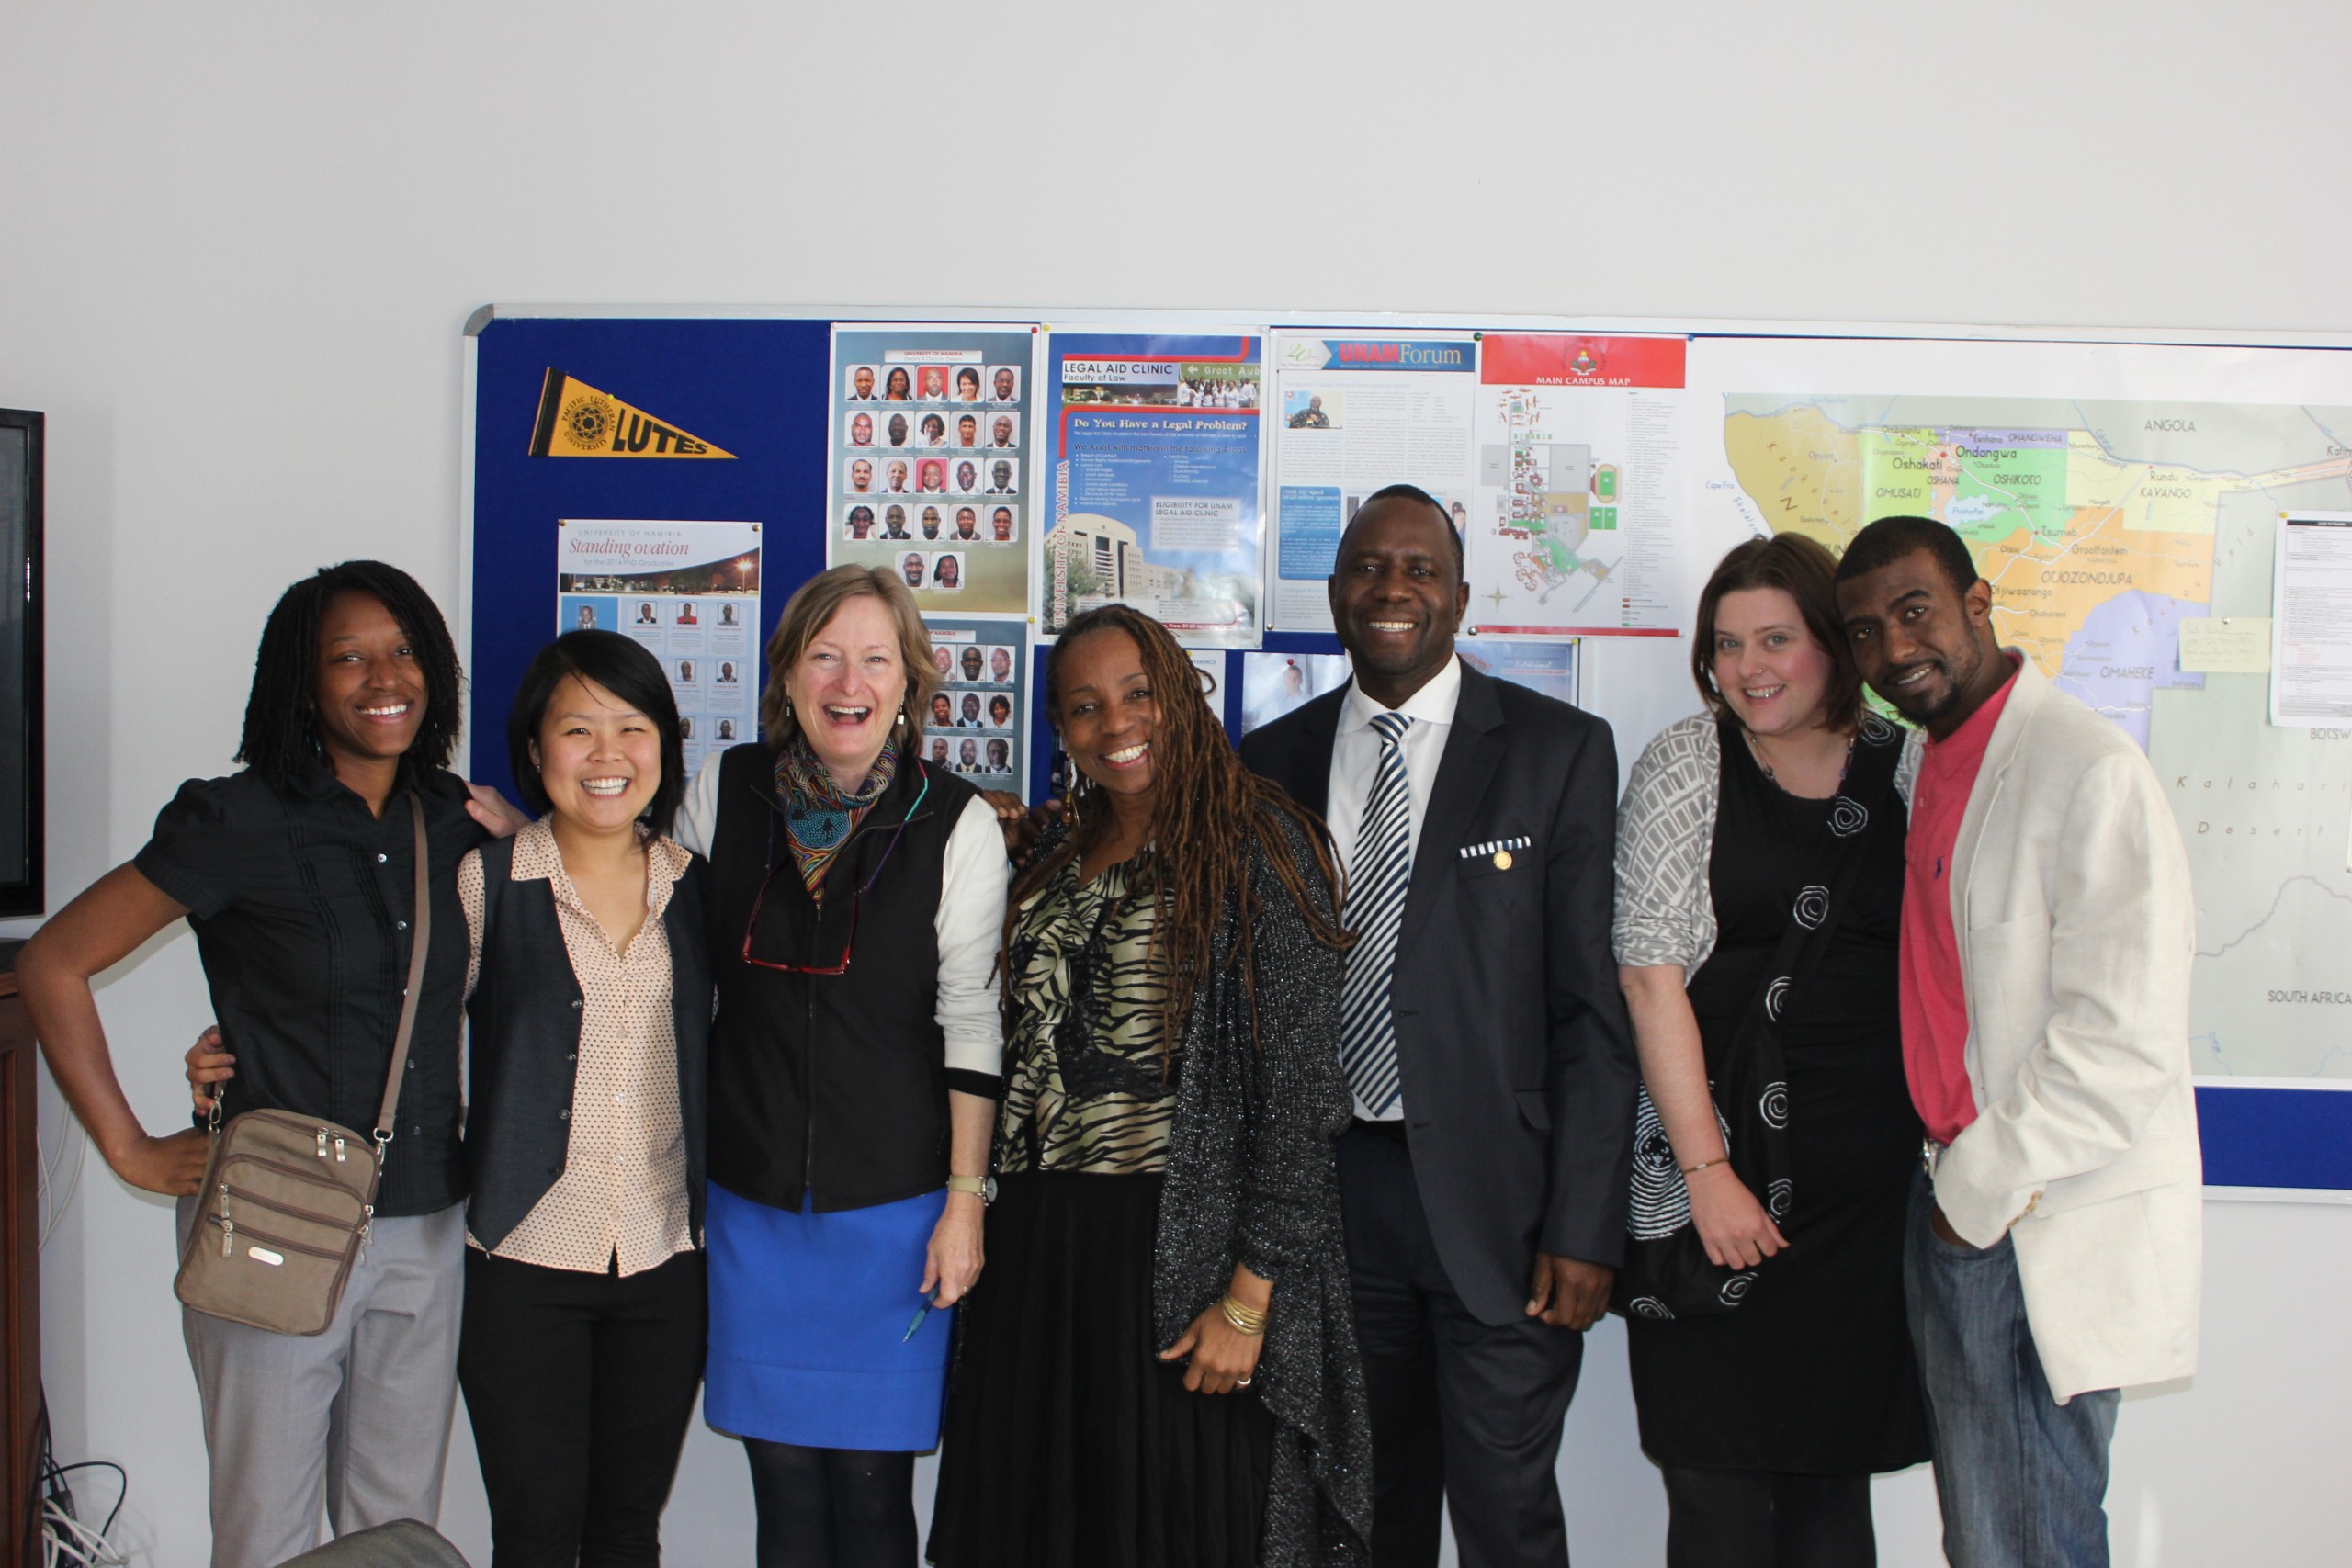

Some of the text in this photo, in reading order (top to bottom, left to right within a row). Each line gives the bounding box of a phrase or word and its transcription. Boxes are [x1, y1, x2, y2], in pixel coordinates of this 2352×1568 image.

[1064, 363, 1174, 375] LEGAL AID CLINIC
[1204, 366, 1233, 375] Groot
[1063, 374, 1095, 383] Faculty
[1536, 376, 1631, 386] MAIN CAMPUS MAP
[562, 396, 616, 451] PACIFIC LUTHERAN UNIVERSITY
[1074, 419, 1089, 428] Do
[1094, 419, 1116, 429] You
[1120, 419, 1148, 429] Have
[1163, 420, 1192, 431] Legal
[1196, 420, 1247, 430] Problem?
[2145, 420, 2196, 432] ANGOLA
[612, 408, 707, 454] LUTES
[2008, 434, 2063, 443] OHANGWENA
[1186, 446, 1221, 455] following
[1809, 451, 1834, 461] Opuwo
[1956, 446, 2017, 460] Ondangwa
[1893, 457, 1943, 470] Oshakati
[1927, 476, 1959, 485] OSHANA
[1993, 474, 2042, 485] OSHIKOTO
[2149, 472, 2179, 482] Rundu
[1705, 481, 1721, 490] Cape
[1876, 487, 1922, 499] OMUSATI
[2140, 487, 2192, 499] KAVANGO
[2041, 526, 2077, 537] Tsumeb
[571, 538, 690, 558] Standing ovation
[1055, 461, 1069, 627] UNIVERSITY OF NAMIBIA
[2072, 544, 2128, 556] Grootfontein
[2100, 666, 2155, 680] OMAHEKE
[2176, 775, 2346, 792] Kalahari
[2196, 821, 2323, 837] Desert
[2268, 990, 2352, 1004] SOUTH AFRICA
